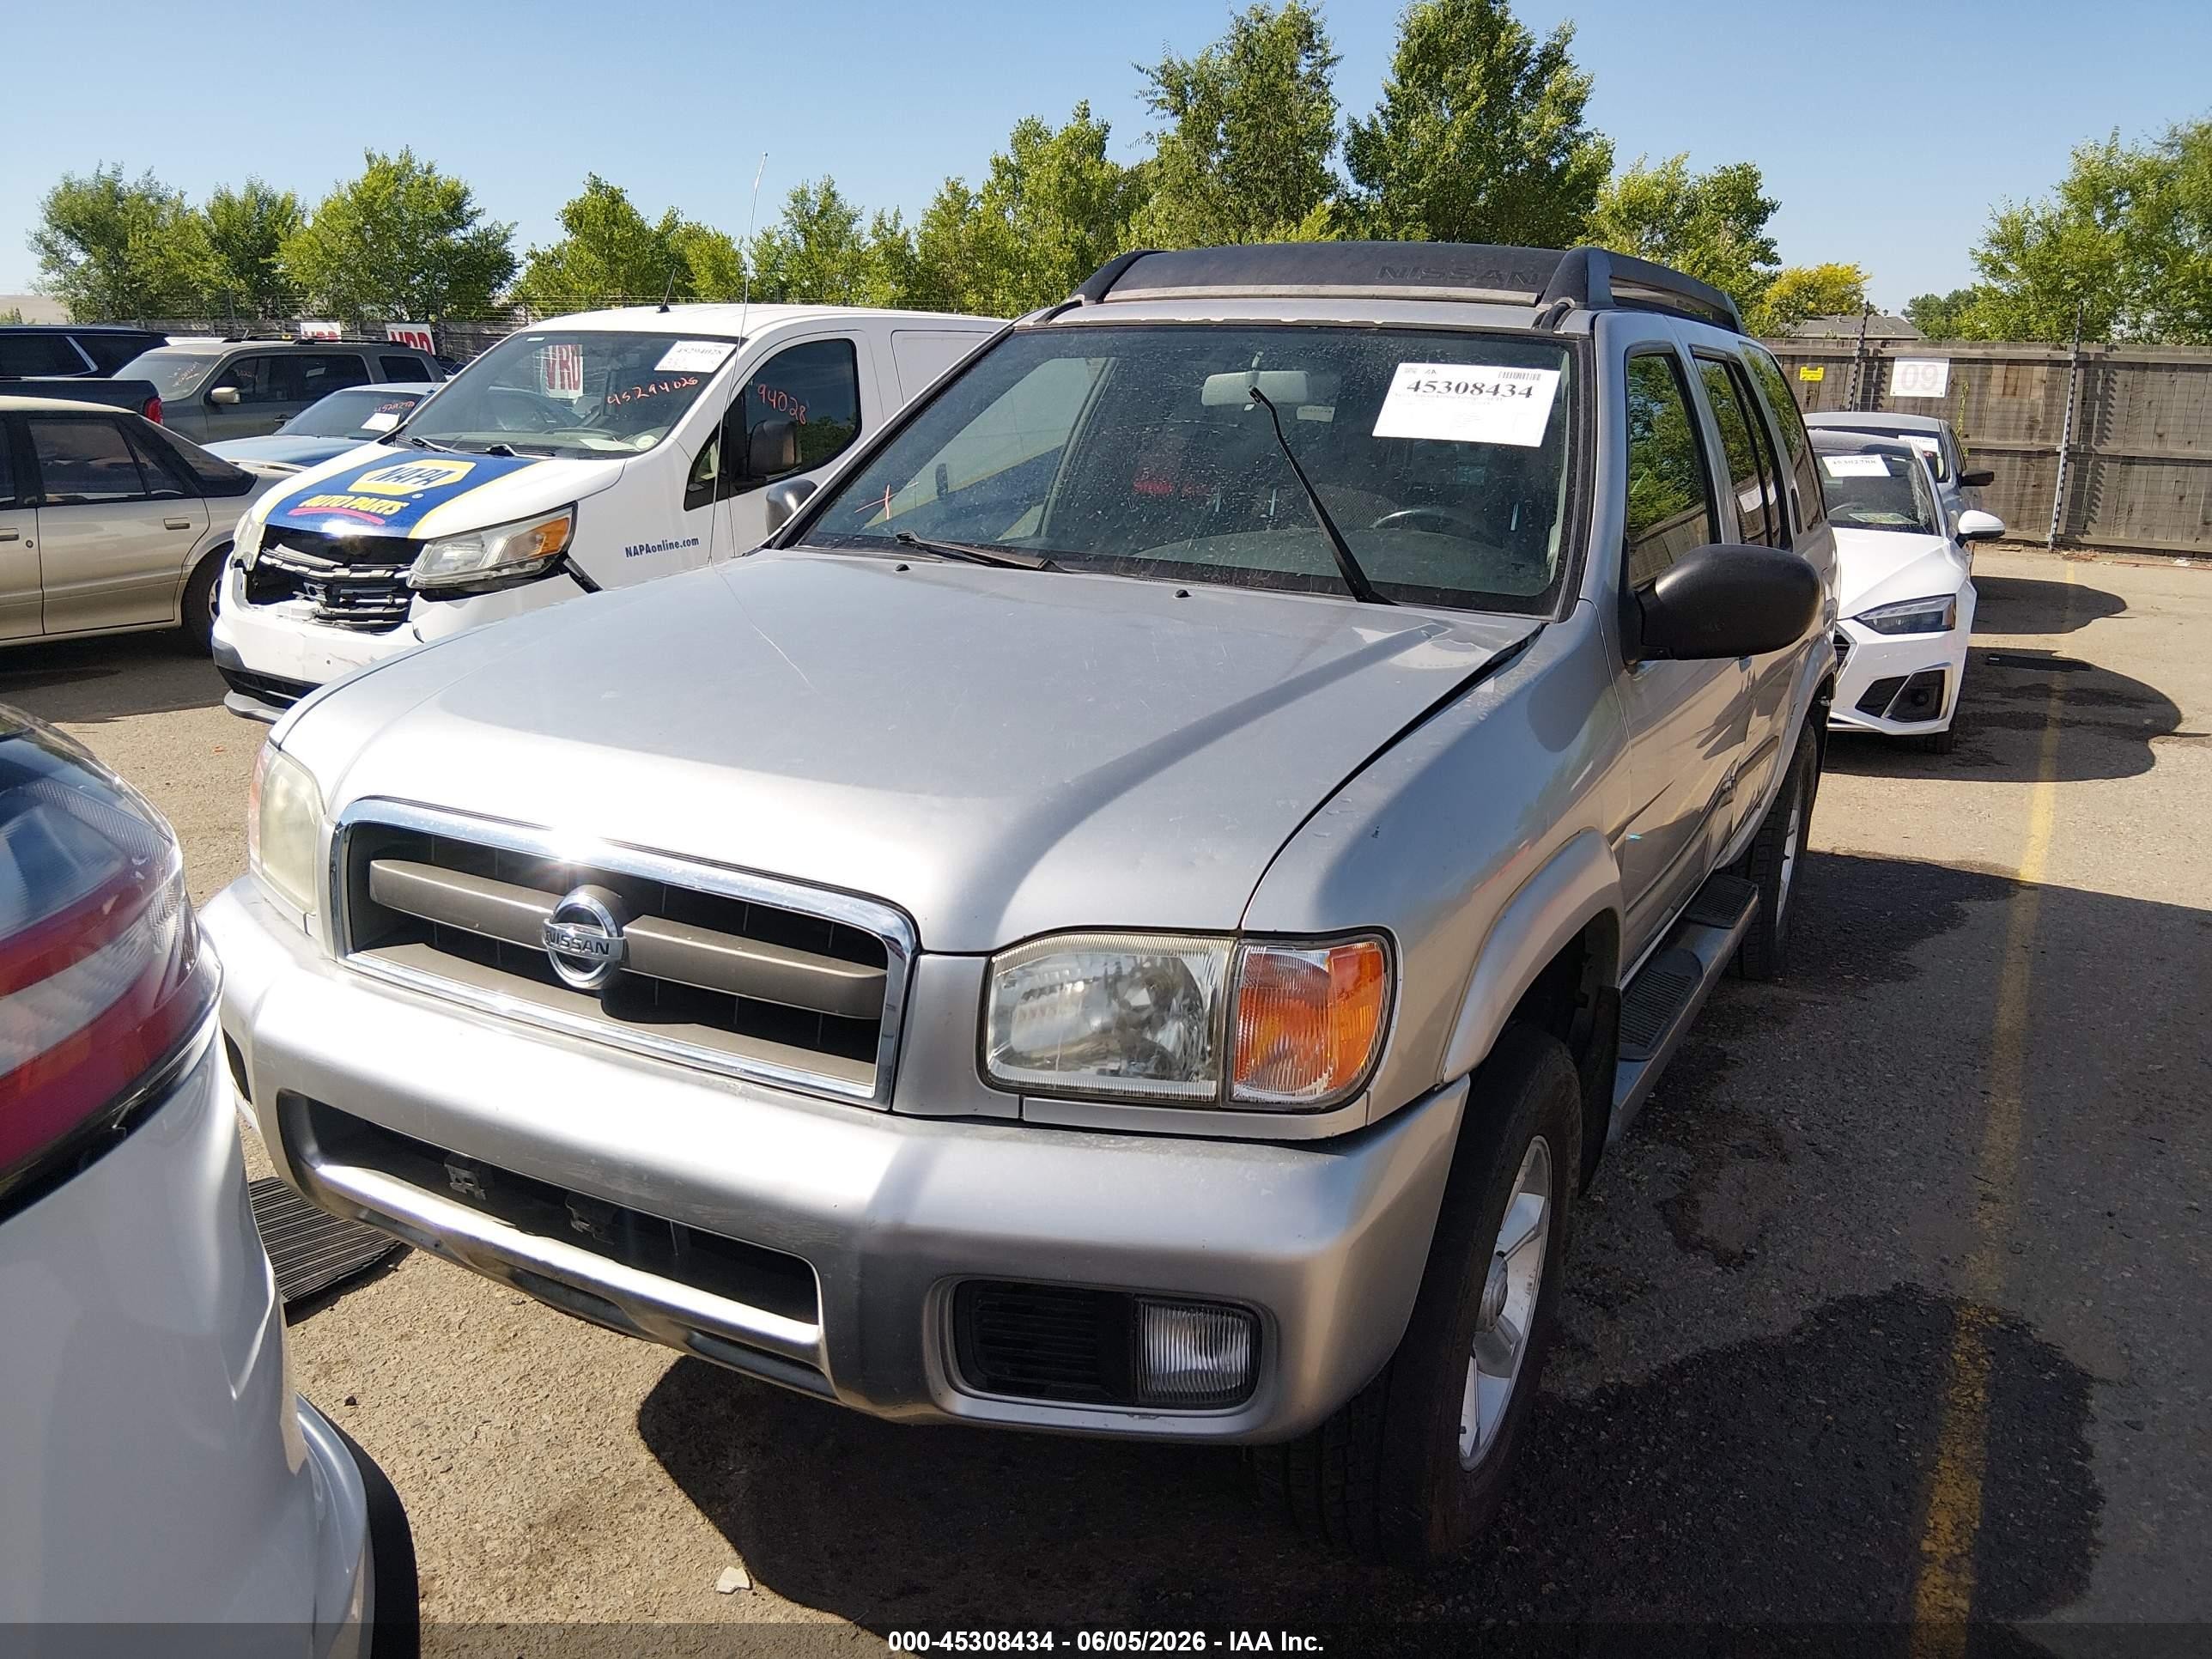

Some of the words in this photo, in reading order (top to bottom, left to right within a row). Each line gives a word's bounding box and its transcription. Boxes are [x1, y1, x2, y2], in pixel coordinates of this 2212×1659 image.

[1376, 265, 1540, 286] NISSAN
[545, 344, 580, 391] VRD
[1901, 363, 1938, 391] 09
[1407, 379, 1534, 398] 45308434
[757, 383, 806, 425] 94028
[366, 466, 457, 486] NAPA
[297, 494, 356, 508] AUTO
[342, 495, 410, 515] PARTS
[624, 537, 700, 558] NAPAonline.com
[544, 930, 610, 956] NISSAN
